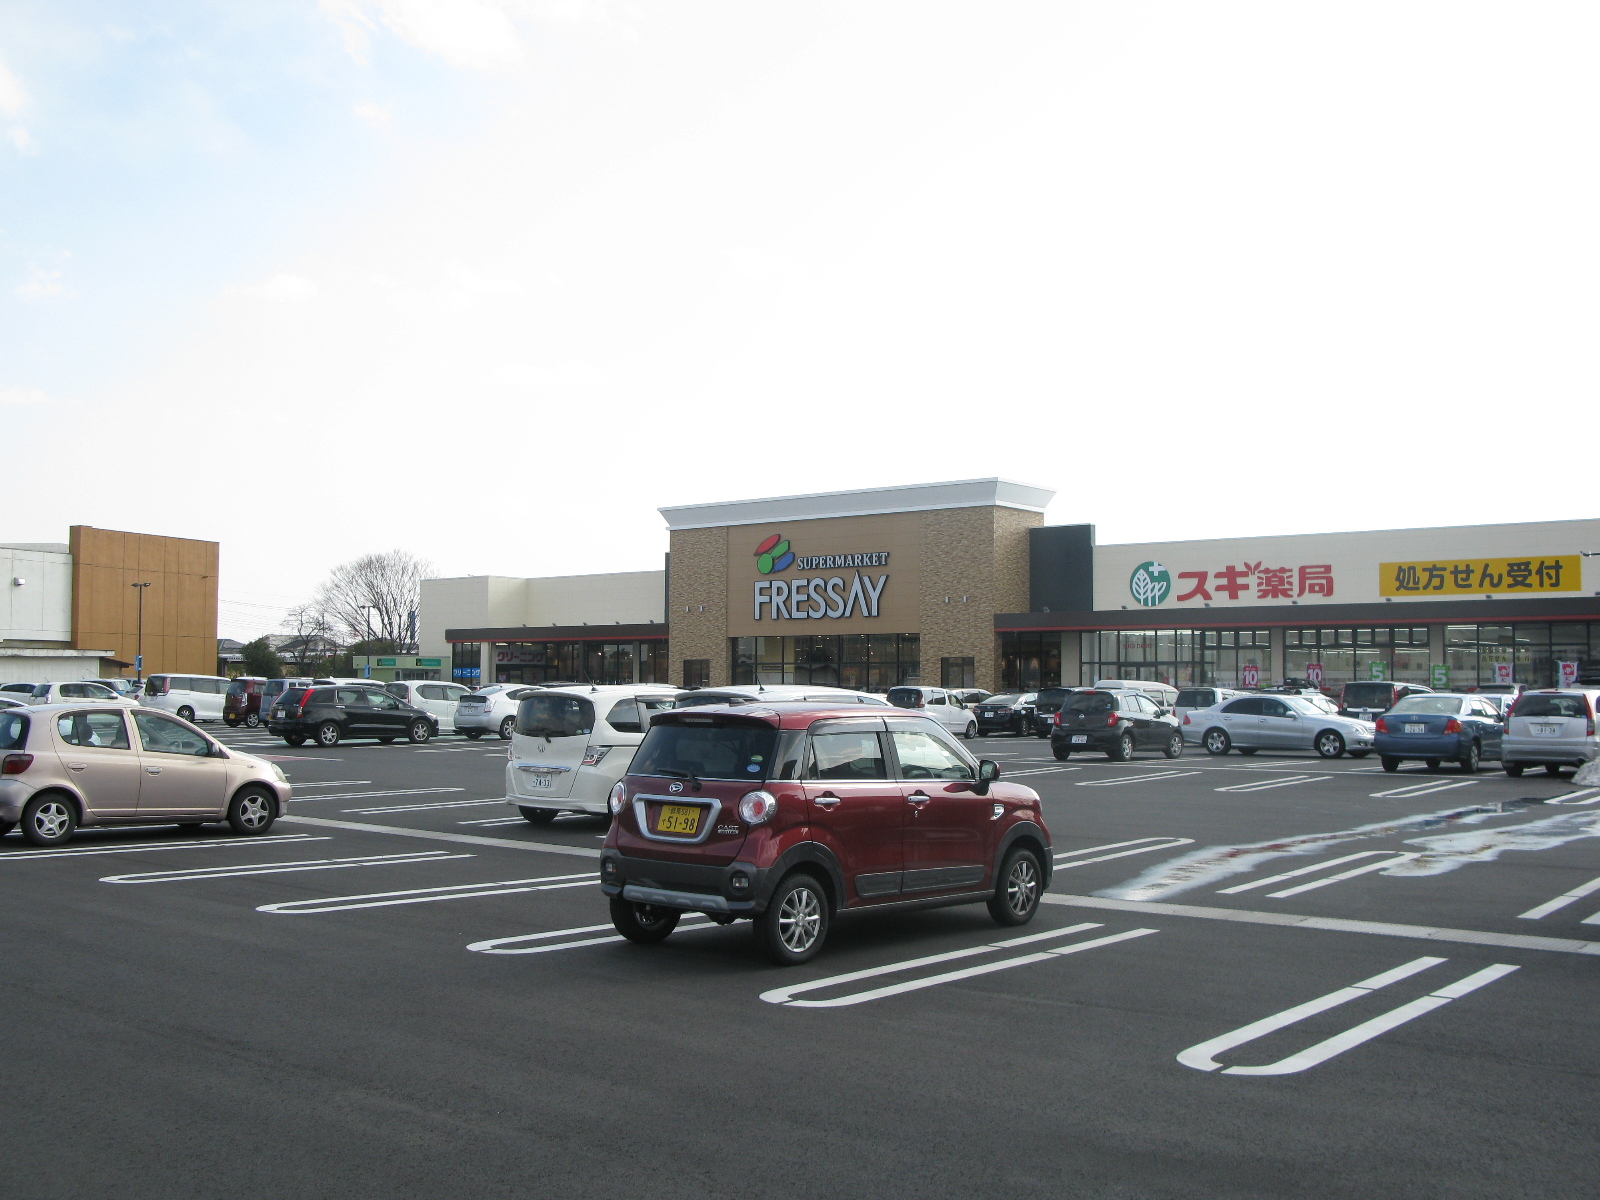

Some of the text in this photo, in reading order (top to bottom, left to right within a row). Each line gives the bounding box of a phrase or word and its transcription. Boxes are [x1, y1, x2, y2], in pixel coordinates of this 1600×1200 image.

[797, 551, 890, 570] SUPERMARKET
[1176, 561, 1334, 601] スギ薬局
[1395, 560, 1563, 591] 処方せん受付
[754, 570, 890, 620] FRESSAY
[497, 651, 545, 662] クリーニング
[453, 669, 480, 677] クリーニング
[1243, 670, 1258, 685] 10
[1307, 669, 1321, 681] 10
[1372, 667, 1384, 681] 5
[1434, 669, 1447, 685] 5
